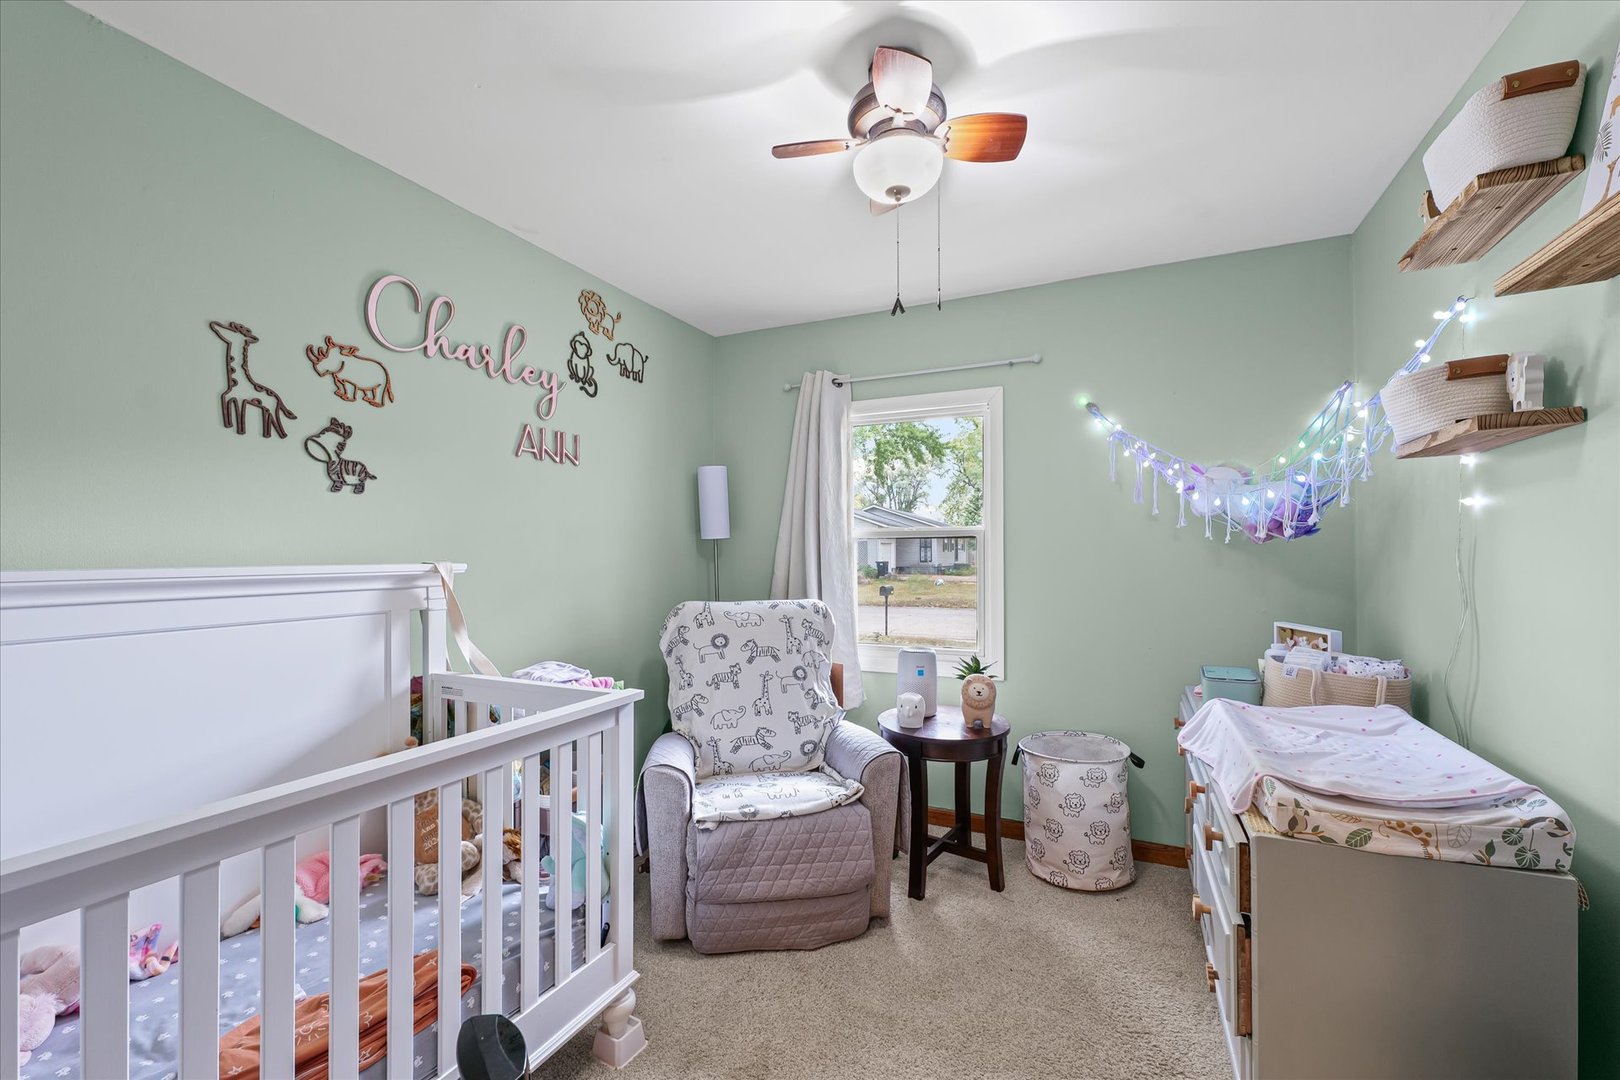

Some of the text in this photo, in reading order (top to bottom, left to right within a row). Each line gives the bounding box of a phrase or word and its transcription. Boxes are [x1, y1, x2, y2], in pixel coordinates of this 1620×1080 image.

[365, 274, 567, 420] Charley
[515, 423, 581, 466] ANN
[423, 836, 439, 851] 202
